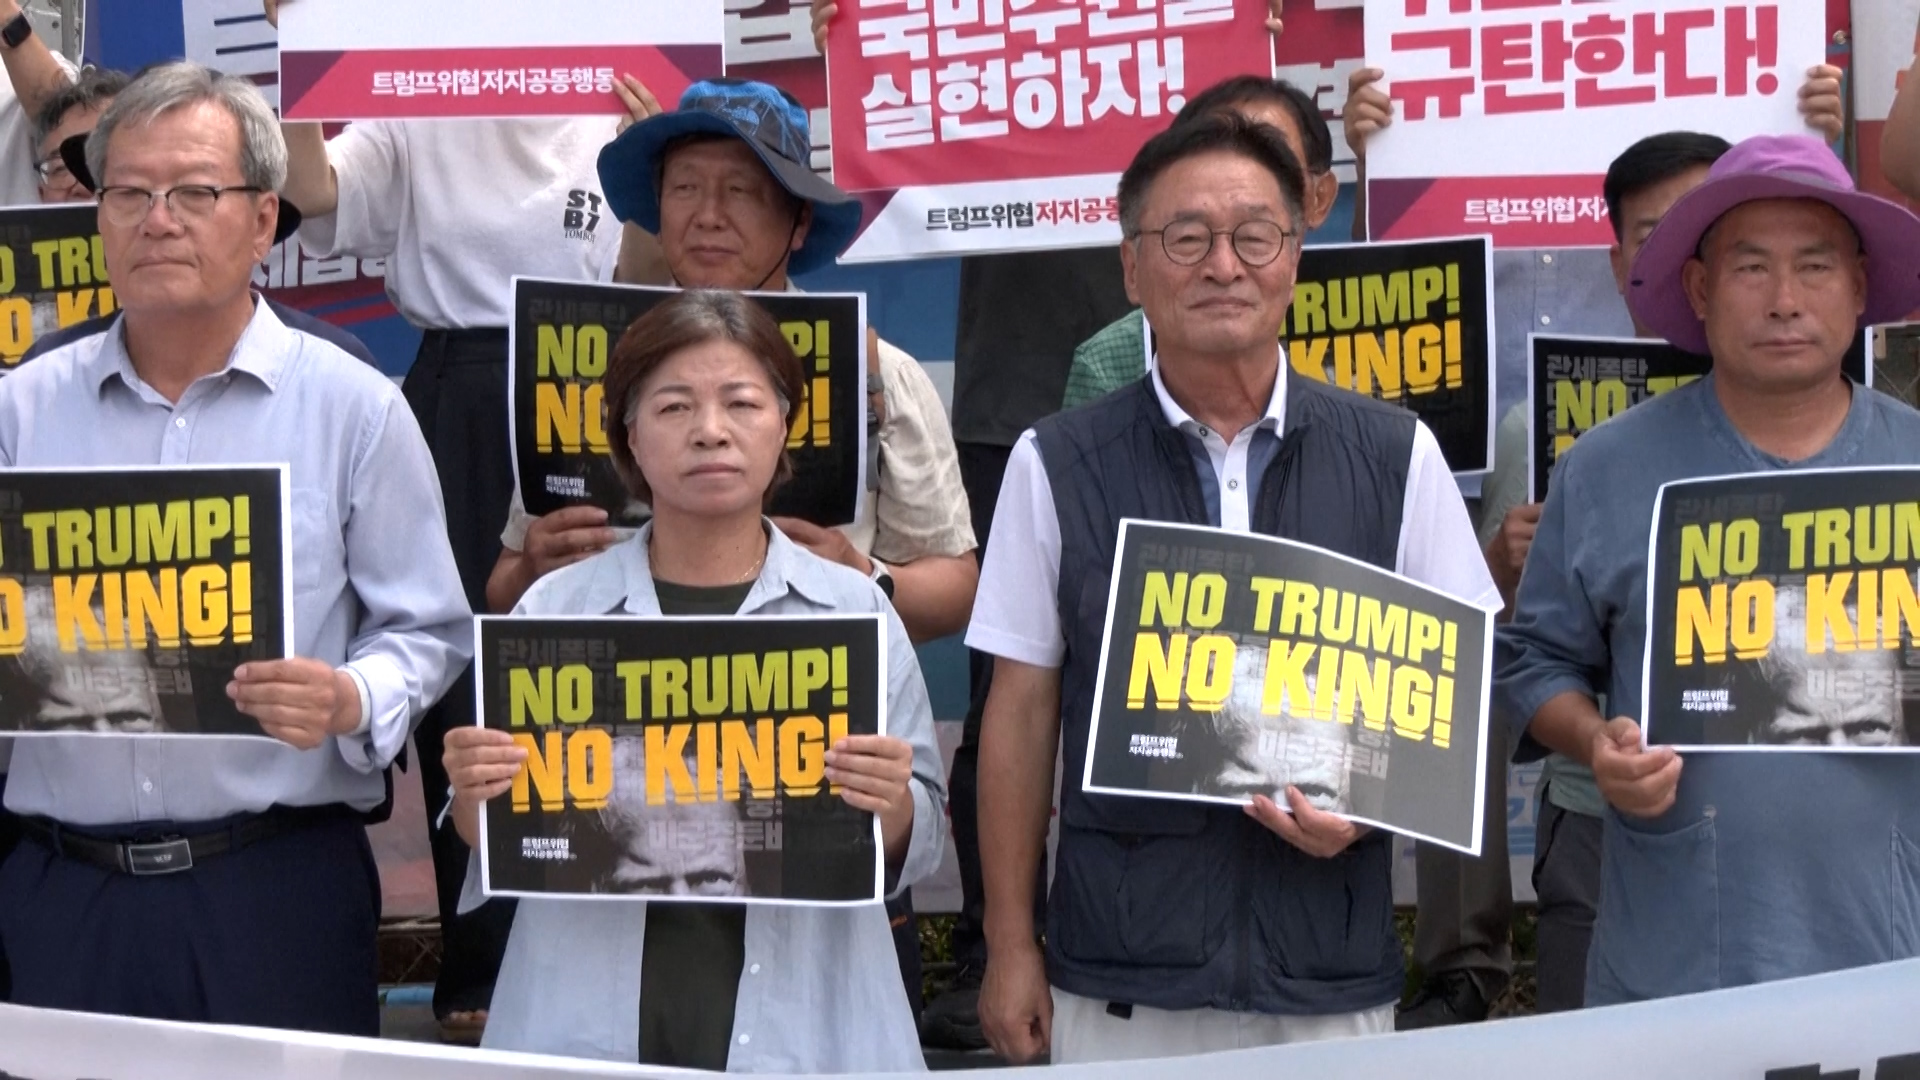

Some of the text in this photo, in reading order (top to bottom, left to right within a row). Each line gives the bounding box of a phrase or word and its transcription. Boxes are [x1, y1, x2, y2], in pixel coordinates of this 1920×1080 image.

[861, 36, 1188, 151] 실현하자!
[1390, 5, 1779, 121] 규탄한다!
[31, 234, 109, 290] TRU
[1279, 262, 1461, 337] RUMP!
[537, 324, 608, 378] NO
[1289, 318, 1463, 400] KING!
[1555, 379, 1629, 431] NO
[23, 494, 251, 571] TRUMP!
[1679, 517, 1761, 582] NO
[52, 560, 253, 653] KING!
[1139, 570, 1458, 673] NO TRUMP!
[1675, 566, 1920, 667] NO KIN
[509, 646, 849, 727] NO TRUMP!
[1126, 631, 1455, 750] NO KING!
[510, 712, 850, 814] NO KING!
